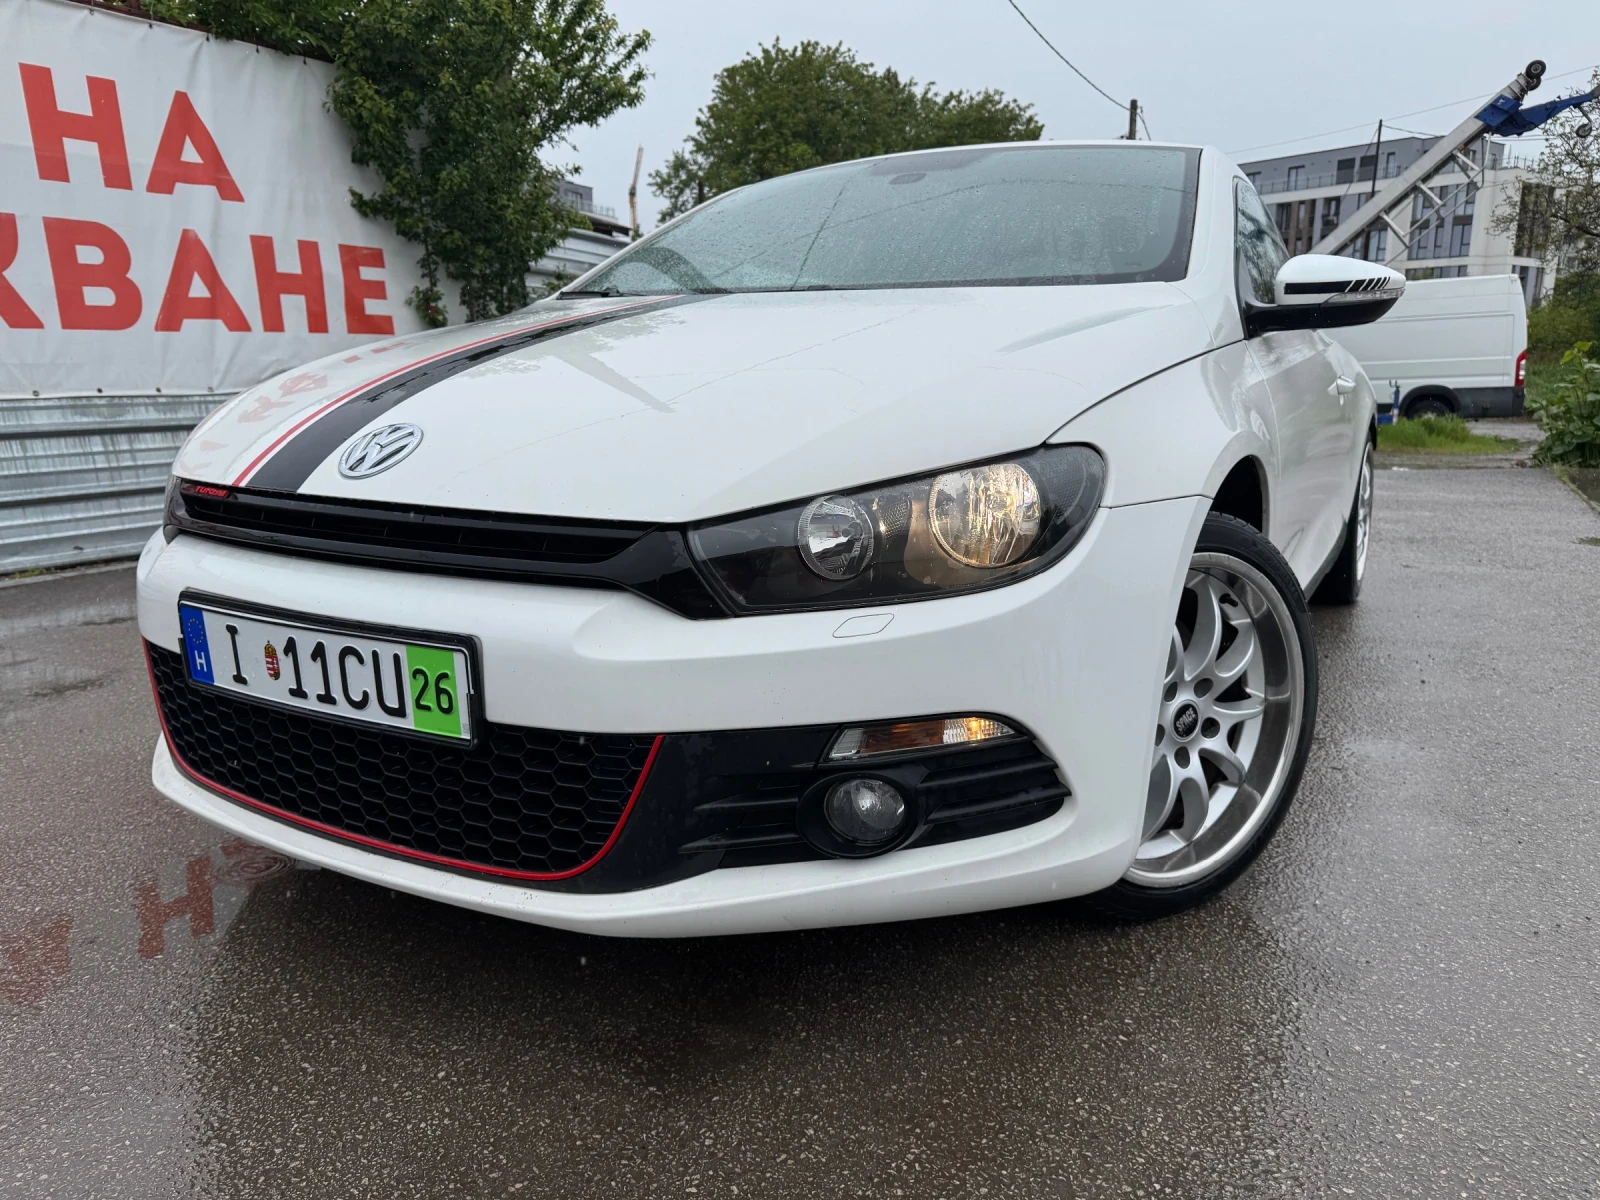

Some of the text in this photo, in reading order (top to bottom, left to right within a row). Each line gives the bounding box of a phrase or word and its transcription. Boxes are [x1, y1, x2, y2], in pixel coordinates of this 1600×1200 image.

[18, 62, 245, 203] НА
[194, 650, 207, 672] H
[283, 636, 407, 718] 11CU
[412, 667, 455, 715] 26
